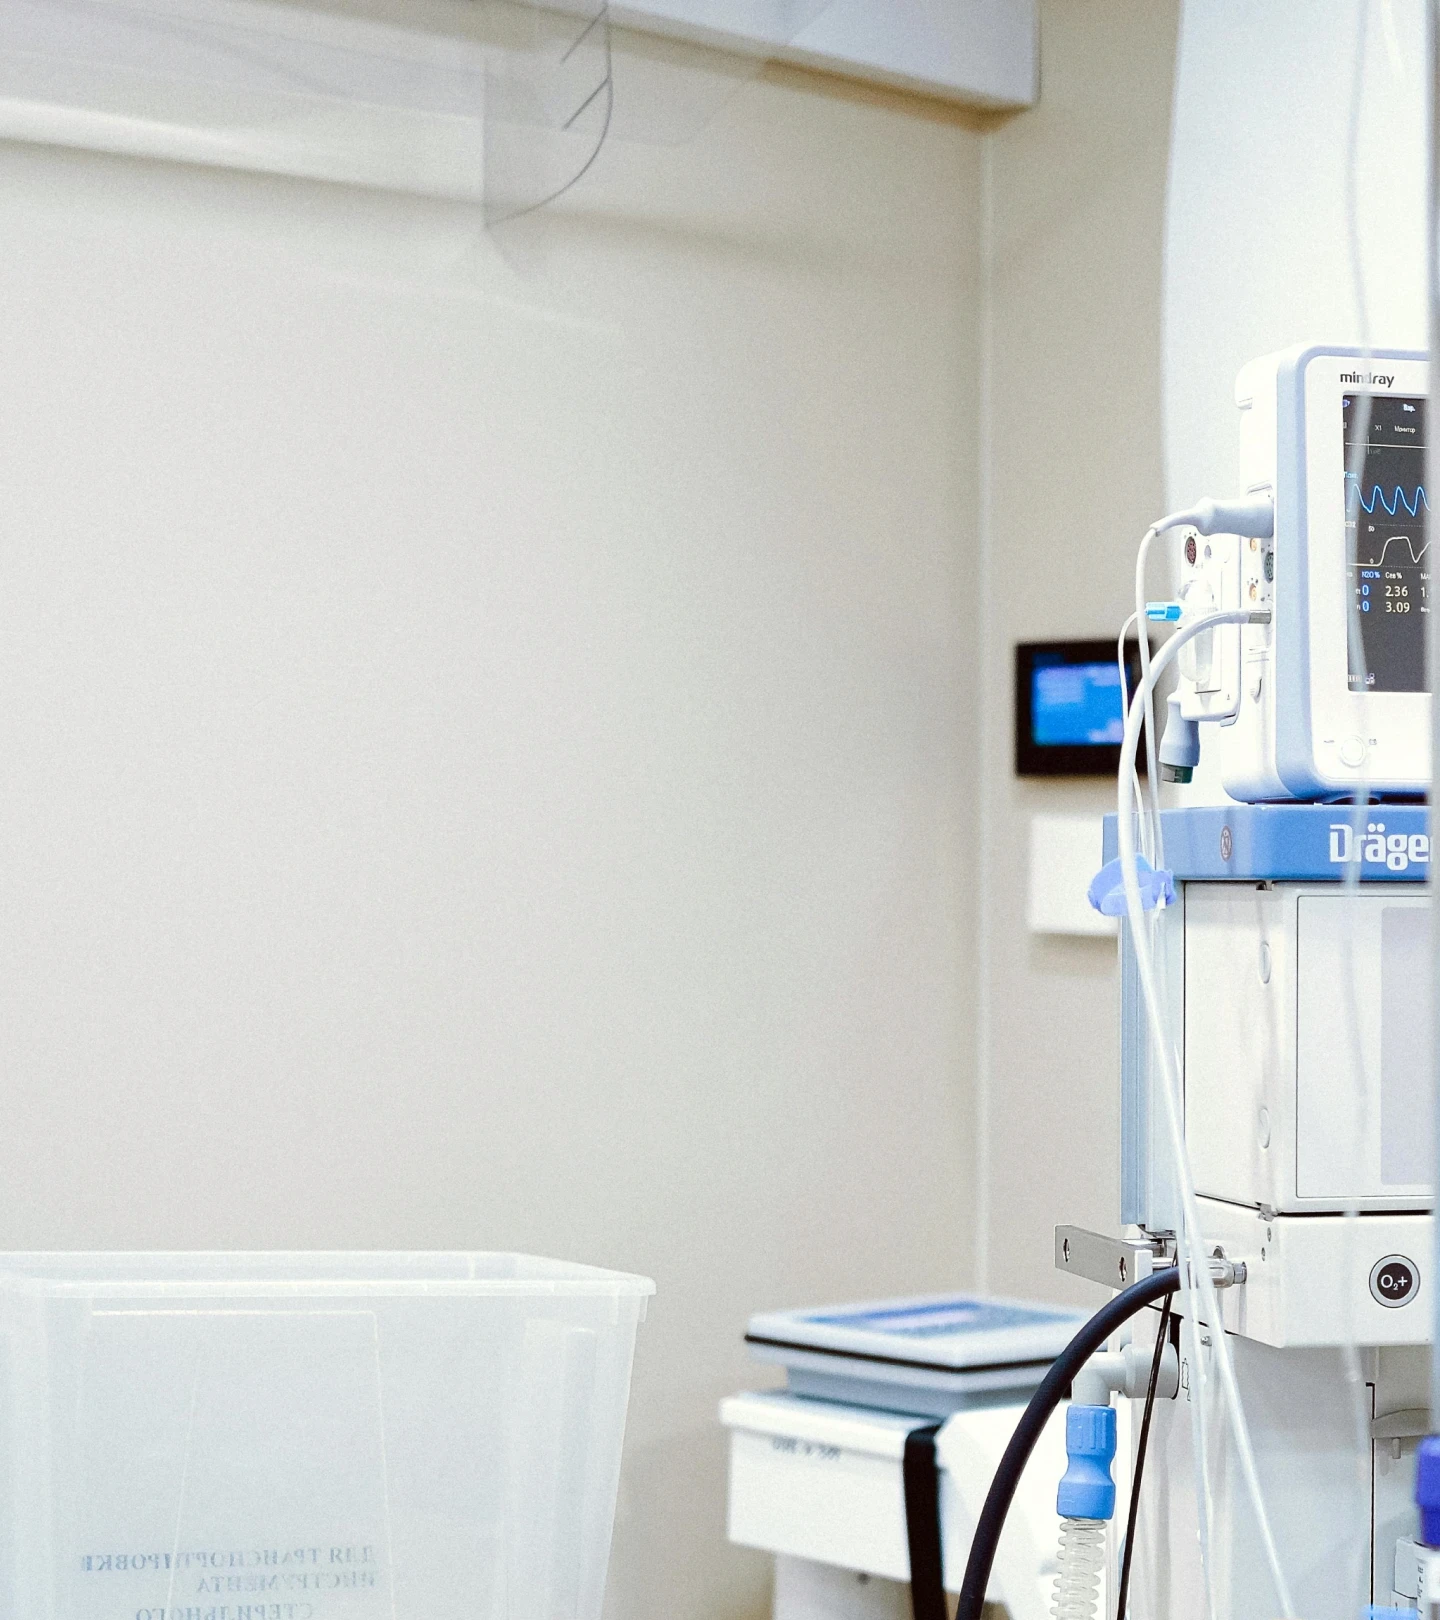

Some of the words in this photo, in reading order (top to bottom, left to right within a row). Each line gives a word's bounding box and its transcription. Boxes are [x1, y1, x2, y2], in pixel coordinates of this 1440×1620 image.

[1340, 371, 1394, 388] mindray
[1362, 584, 1369, 596] 0
[1385, 586, 1408, 596] 2.36
[1362, 600, 1370, 612] 0
[1386, 602, 1410, 612] 3.09
[1329, 822, 1433, 870] Dräge
